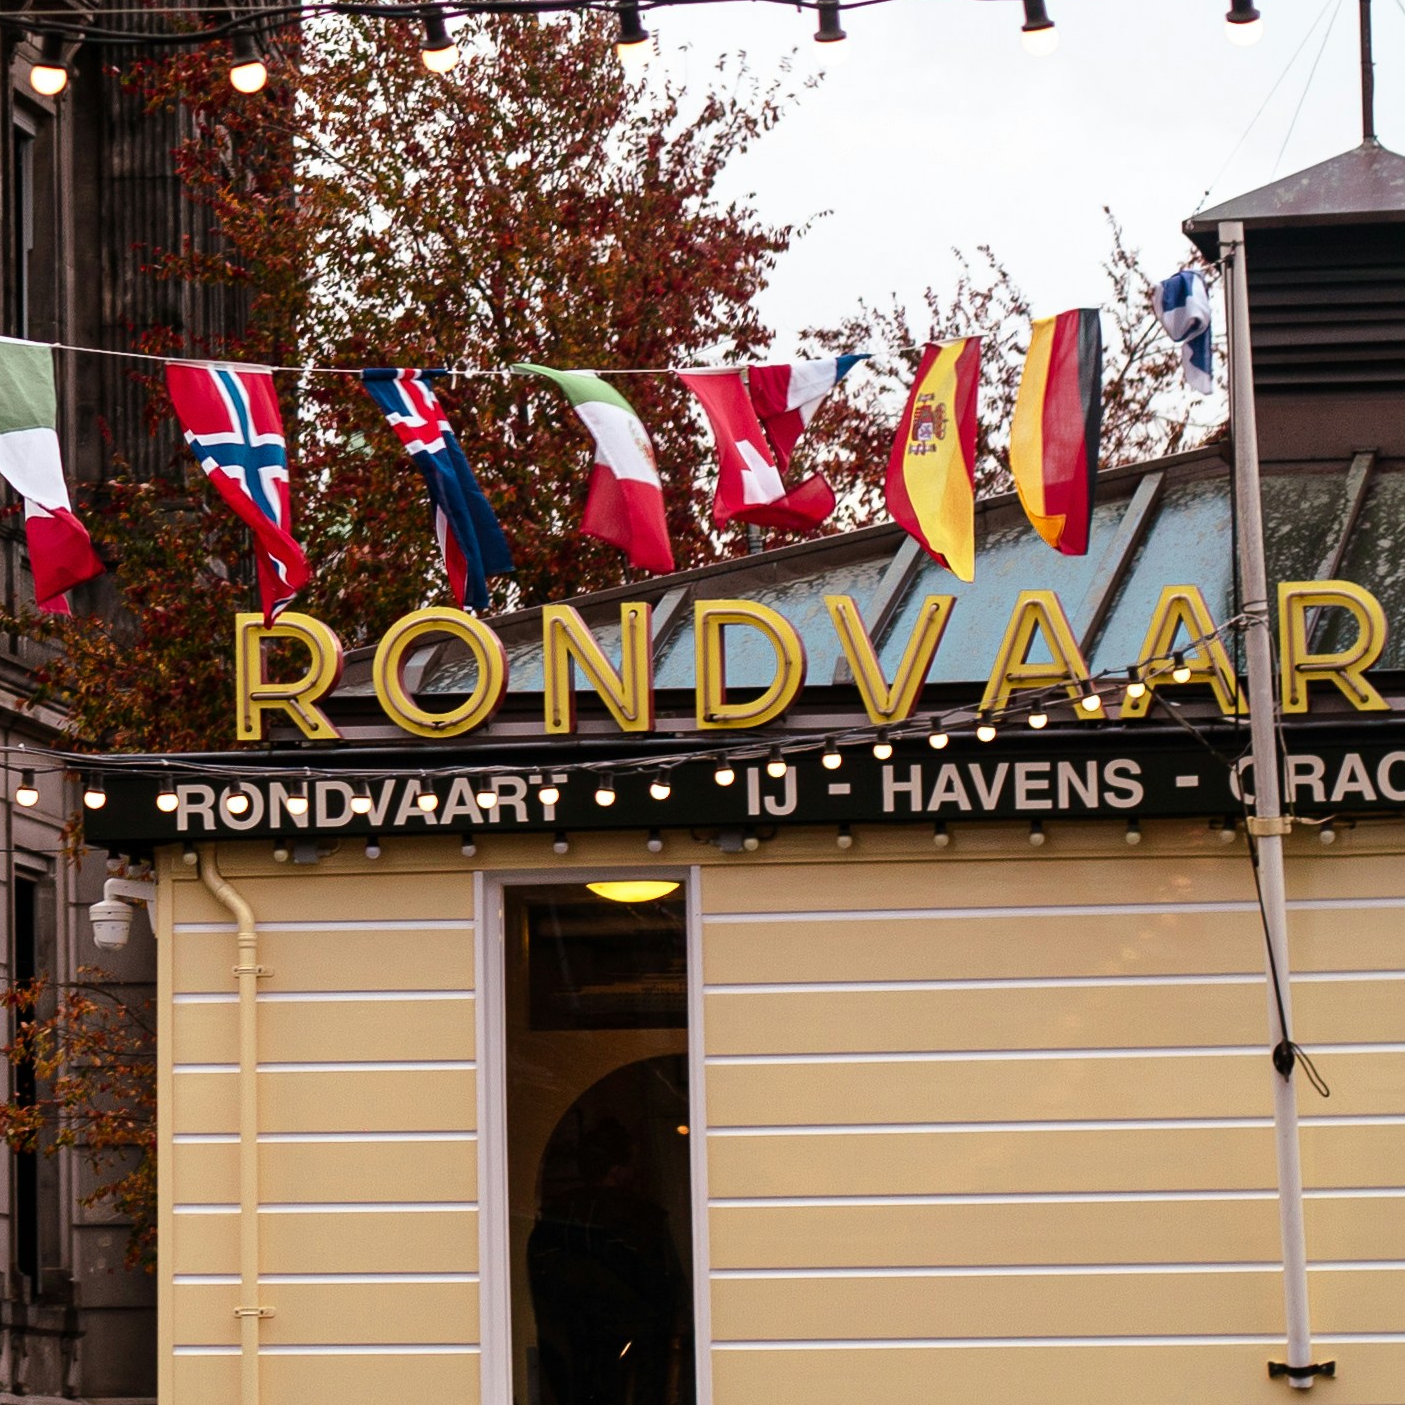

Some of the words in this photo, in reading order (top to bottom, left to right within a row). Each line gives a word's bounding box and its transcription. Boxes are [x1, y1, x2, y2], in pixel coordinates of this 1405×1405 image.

[176, 774, 569, 832] RONDVAART
[746, 764, 798, 816] IJ
[882, 758, 1145, 812] HAVENS
